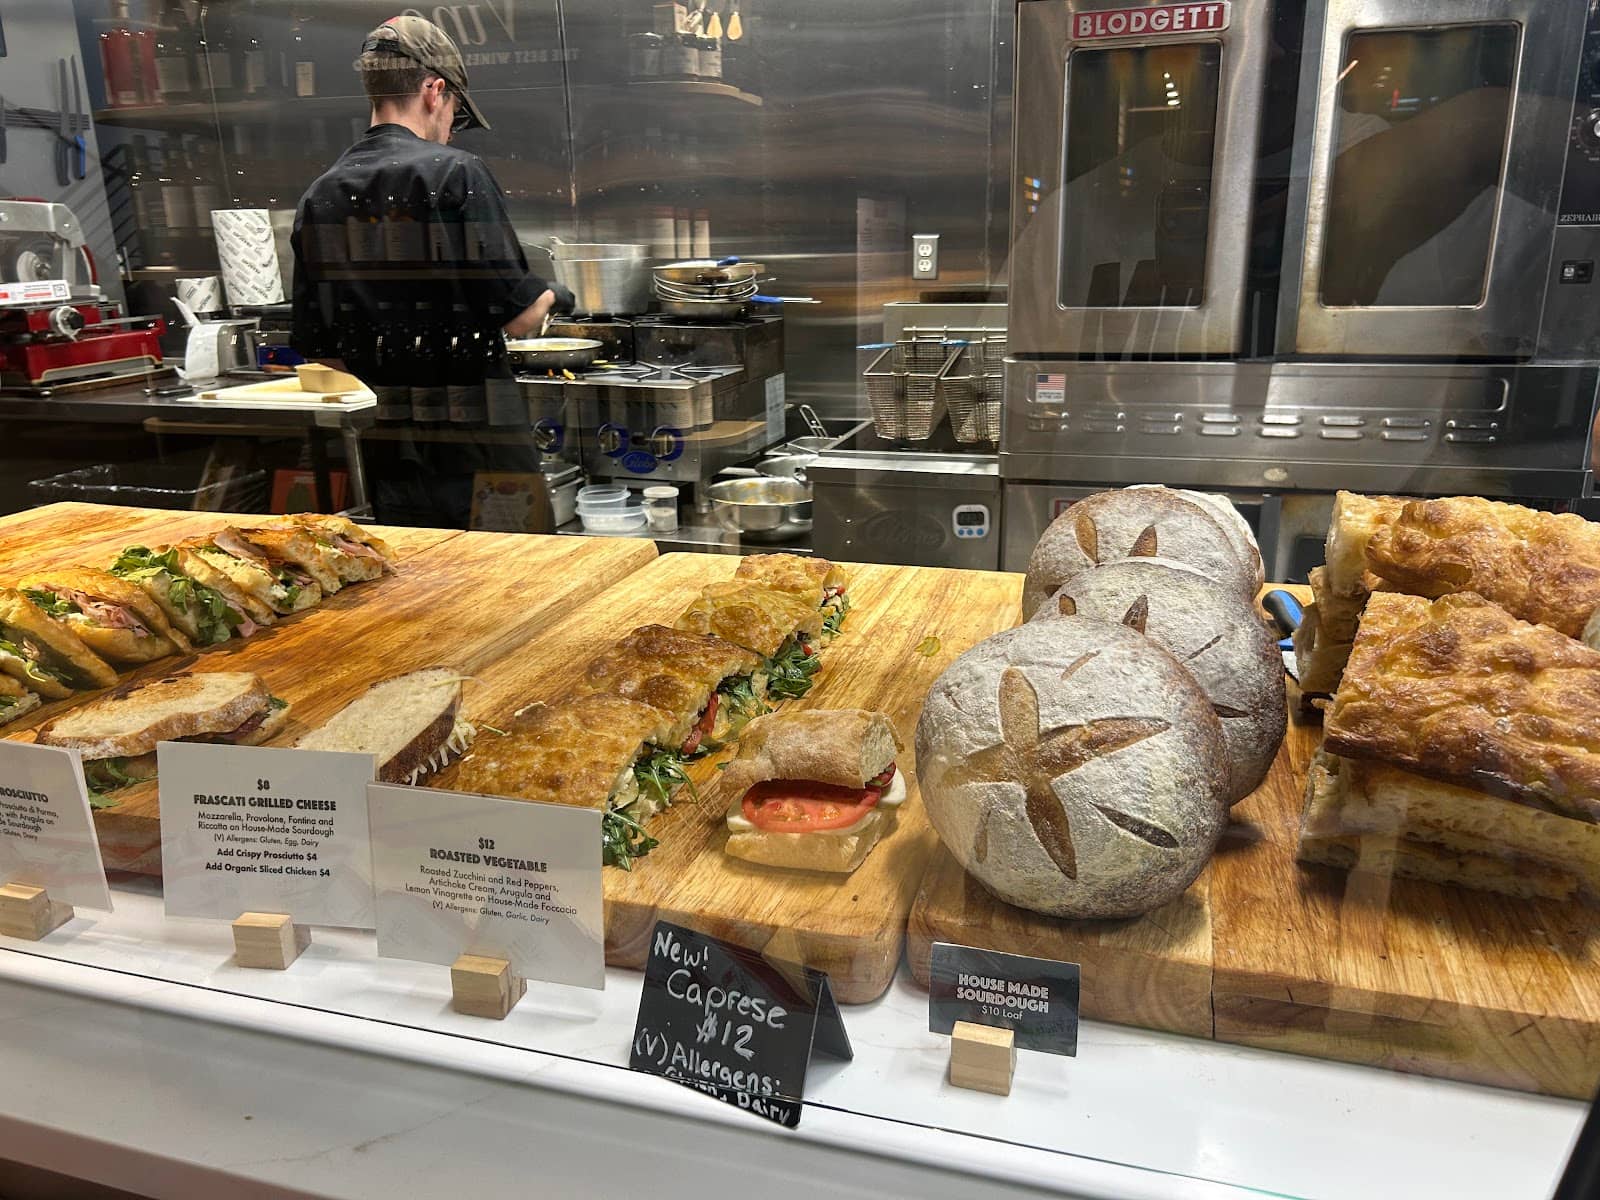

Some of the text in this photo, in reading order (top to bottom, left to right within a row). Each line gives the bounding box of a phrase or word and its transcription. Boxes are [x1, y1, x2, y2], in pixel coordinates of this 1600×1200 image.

[1078, 6, 1218, 37] BLODGETT
[257, 779, 270, 791] $8
[194, 795, 336, 811] FRASCATI GRILLED CHEESE
[198, 812, 334, 826] Mozzarella, Provolone, Fontina and
[229, 823, 240, 831] on
[241, 824, 290, 834] House-Made
[292, 826, 335, 838] Sourdough
[214, 834, 319, 848] (V) Allergens: Gluten, Egg, Dairy
[478, 836, 495, 851] $12
[217, 848, 317, 862] Add Crispy Prosciutto $4
[429, 848, 548, 873] ROASTED VEGETABLE
[205, 862, 331, 877] Add Organic Sliced Chicken $4
[420, 865, 560, 893] Roasted Zucchini and Red Peppers,
[405, 882, 578, 915] Lemon Vinagrette on House-Made Foccacia
[428, 877, 551, 901] Artichoke Cream, Arugula and
[530, 914, 550, 926] Dairy
[654, 931, 709, 971] New!
[958, 973, 1049, 999] HOUSE MADE
[666, 968, 788, 1029] Caprese
[956, 987, 1049, 1013] SOURDOUGH
[981, 1005, 1024, 1021] $10 Loaf
[635, 1027, 782, 1097] (V) Allergens:
[736, 1091, 791, 1126] Dairy
